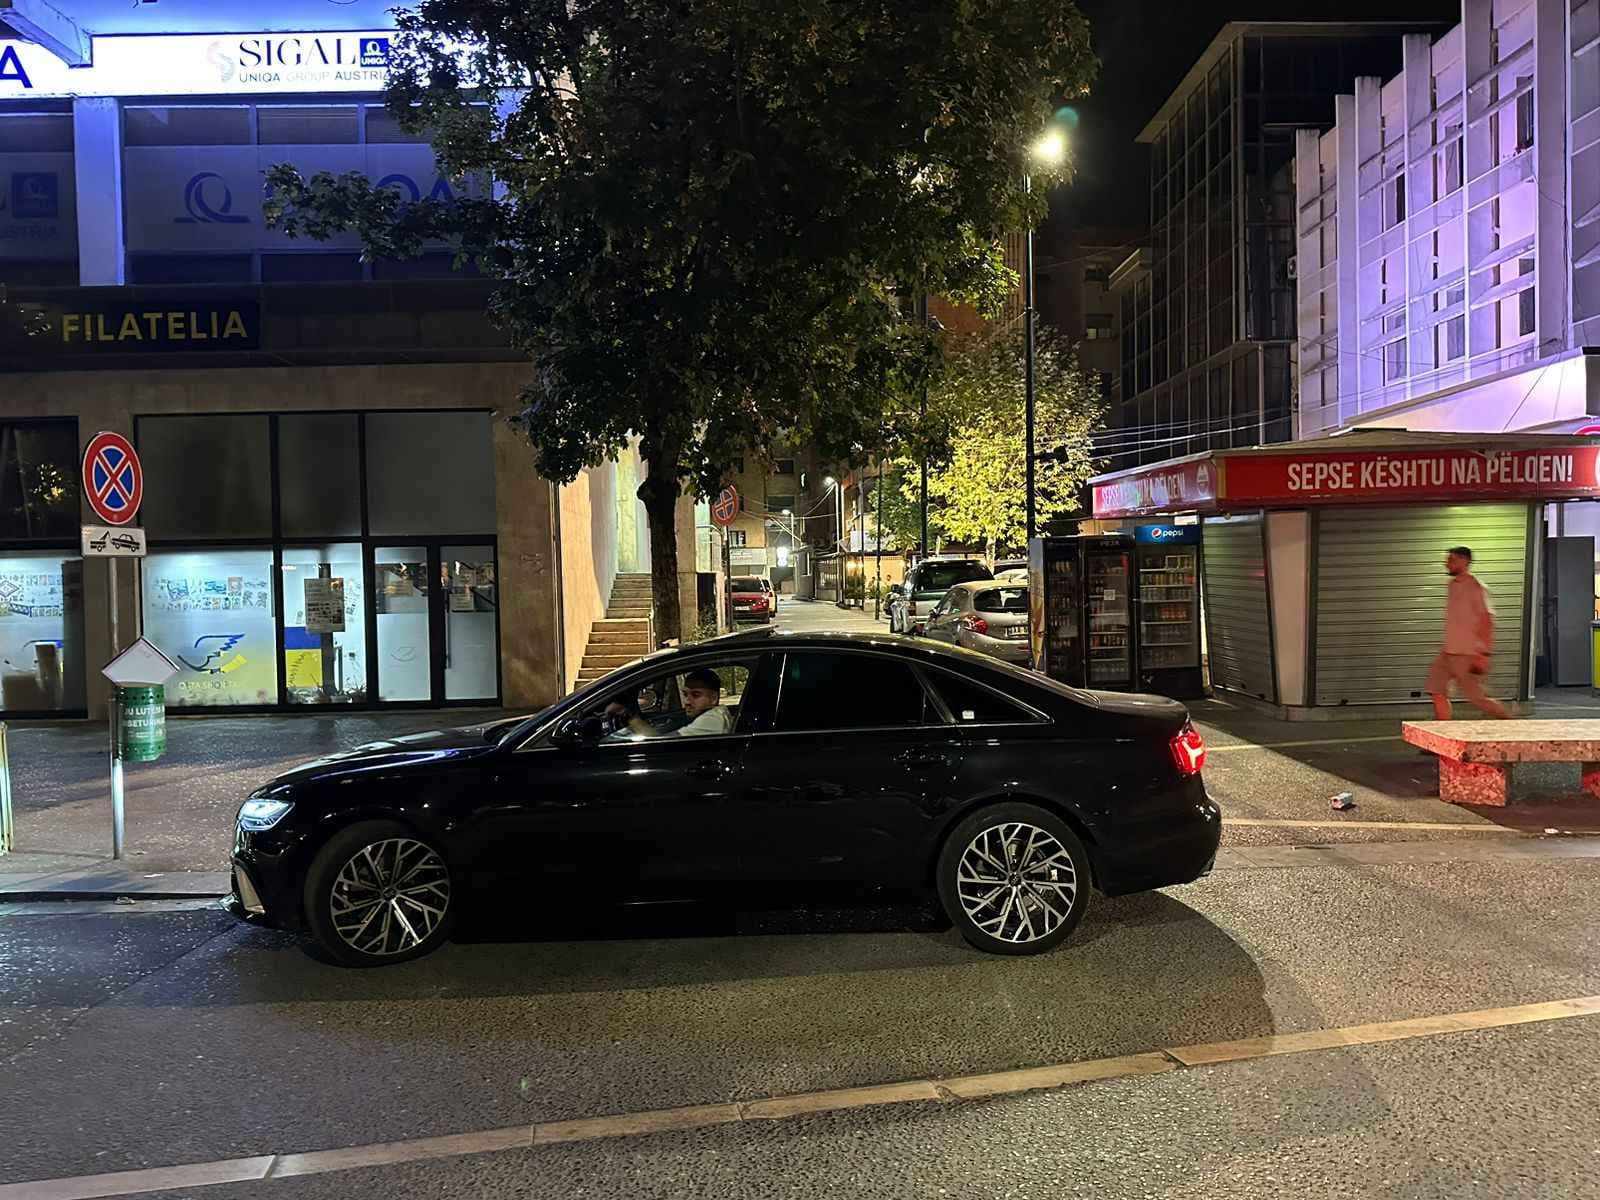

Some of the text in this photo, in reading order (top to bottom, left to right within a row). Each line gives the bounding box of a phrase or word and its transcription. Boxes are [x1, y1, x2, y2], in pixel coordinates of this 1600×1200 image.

[239, 37, 357, 68] SIGAL
[239, 72, 281, 83] UNIQA
[285, 71, 330, 82] GROUP
[62, 310, 249, 342] FILATELIA
[1287, 452, 1573, 491] SEPSE KËSHTU NA PËLQEN!
[1162, 528, 1184, 539] pepsi
